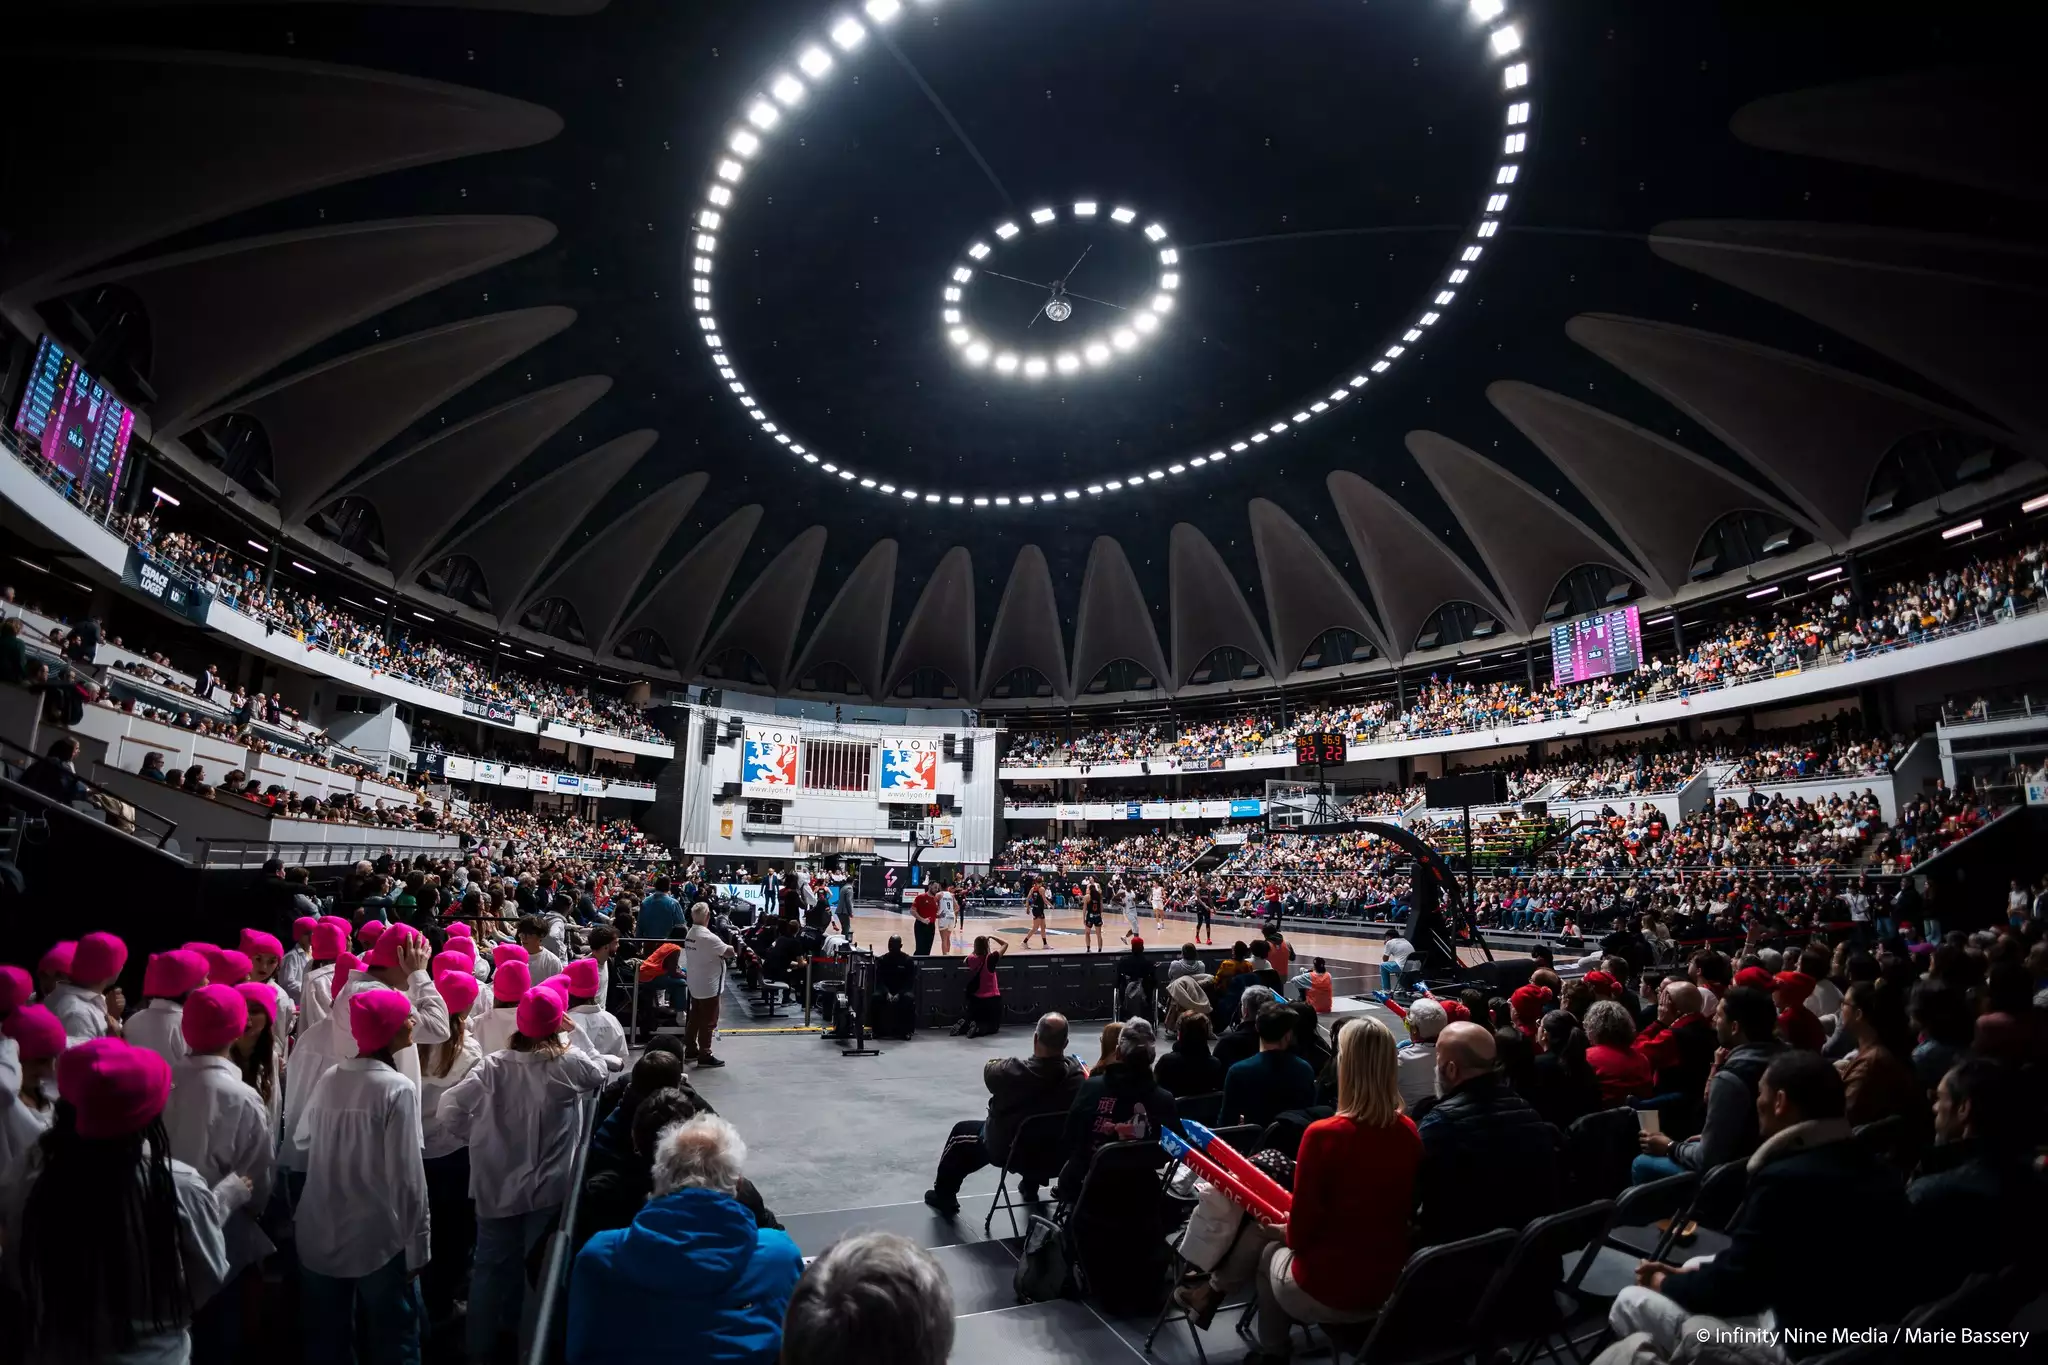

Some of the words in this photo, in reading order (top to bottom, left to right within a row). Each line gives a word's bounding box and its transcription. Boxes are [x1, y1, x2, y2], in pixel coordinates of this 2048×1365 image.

[79, 372, 89, 387] 53
[93, 385, 103, 398] 52
[68, 431, 84, 448] 36.9
[141, 564, 169, 588] ESPACE
[141, 577, 164, 597] LOGES
[745, 730, 798, 745] LYON
[882, 739, 937, 750] LYON
[1297, 735, 1313, 747] 36.9
[1322, 734, 1341, 745] 36.9
[1300, 746, 1315, 762] 22
[1325, 745, 1343, 761] 22
[749, 786, 791, 794] www.lyon.fr
[887, 790, 931, 799] www.lyon.fr
[1185, 1157, 1221, 1189] VILLE
[1224, 1186, 1242, 1204] DE
[1246, 1203, 1274, 1226] LYO
